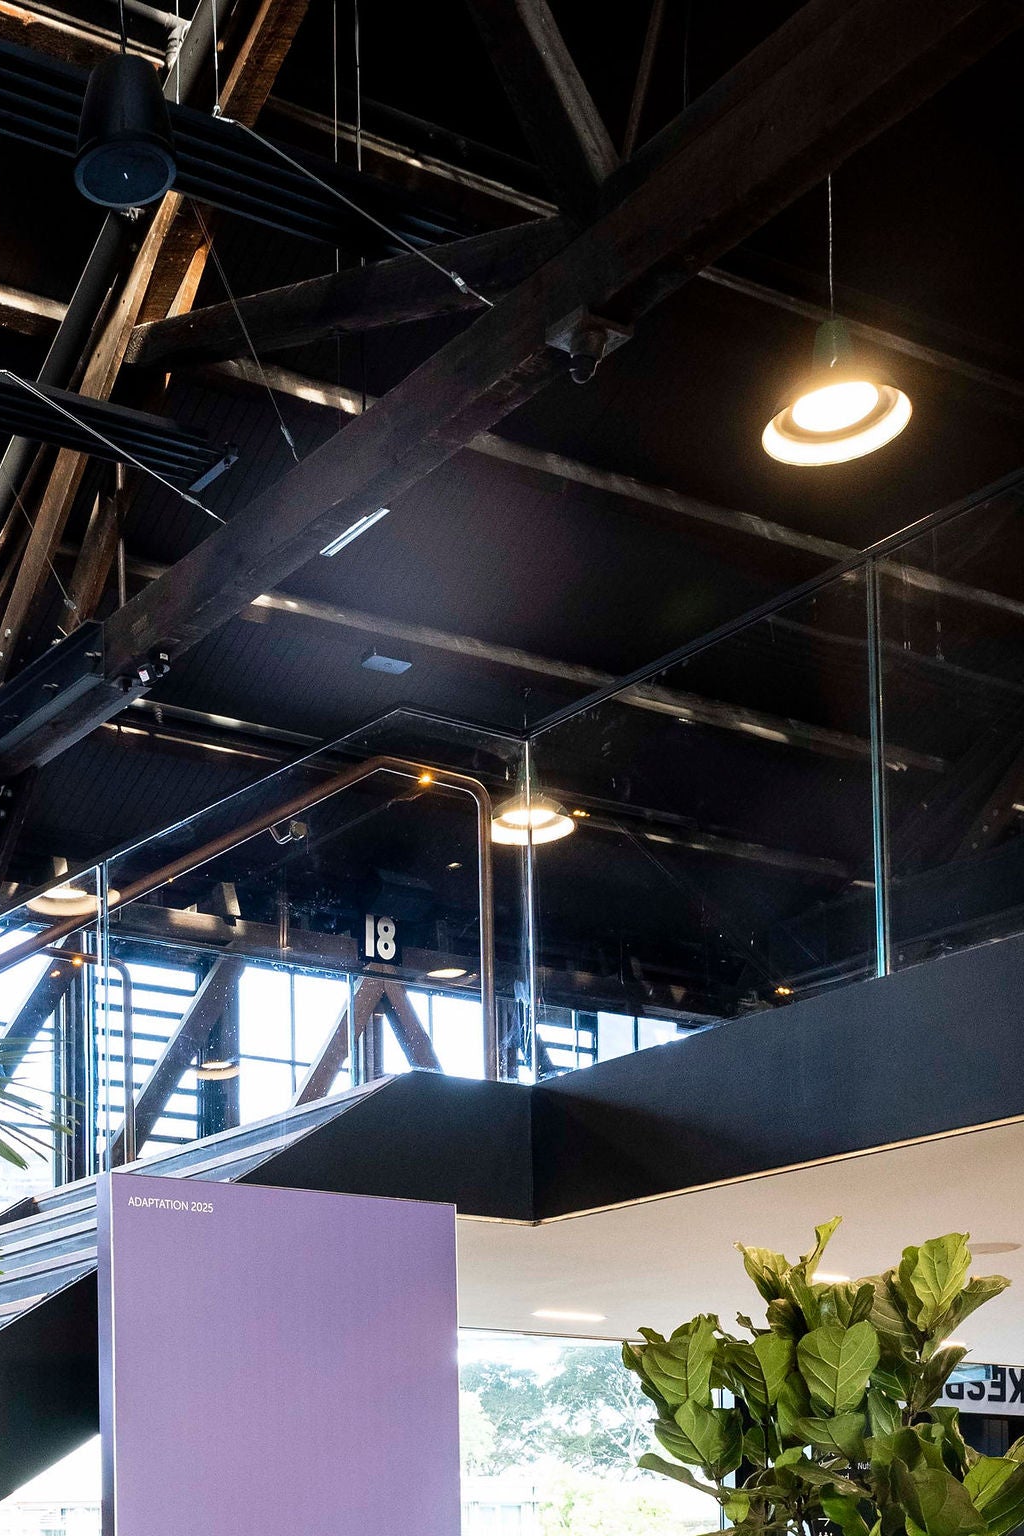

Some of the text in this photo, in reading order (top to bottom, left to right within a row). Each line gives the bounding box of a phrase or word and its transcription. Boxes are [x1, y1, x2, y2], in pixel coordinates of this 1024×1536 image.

[365, 914, 396, 960] 18
[128, 1196, 214, 1213] ADAPTATION 2025
